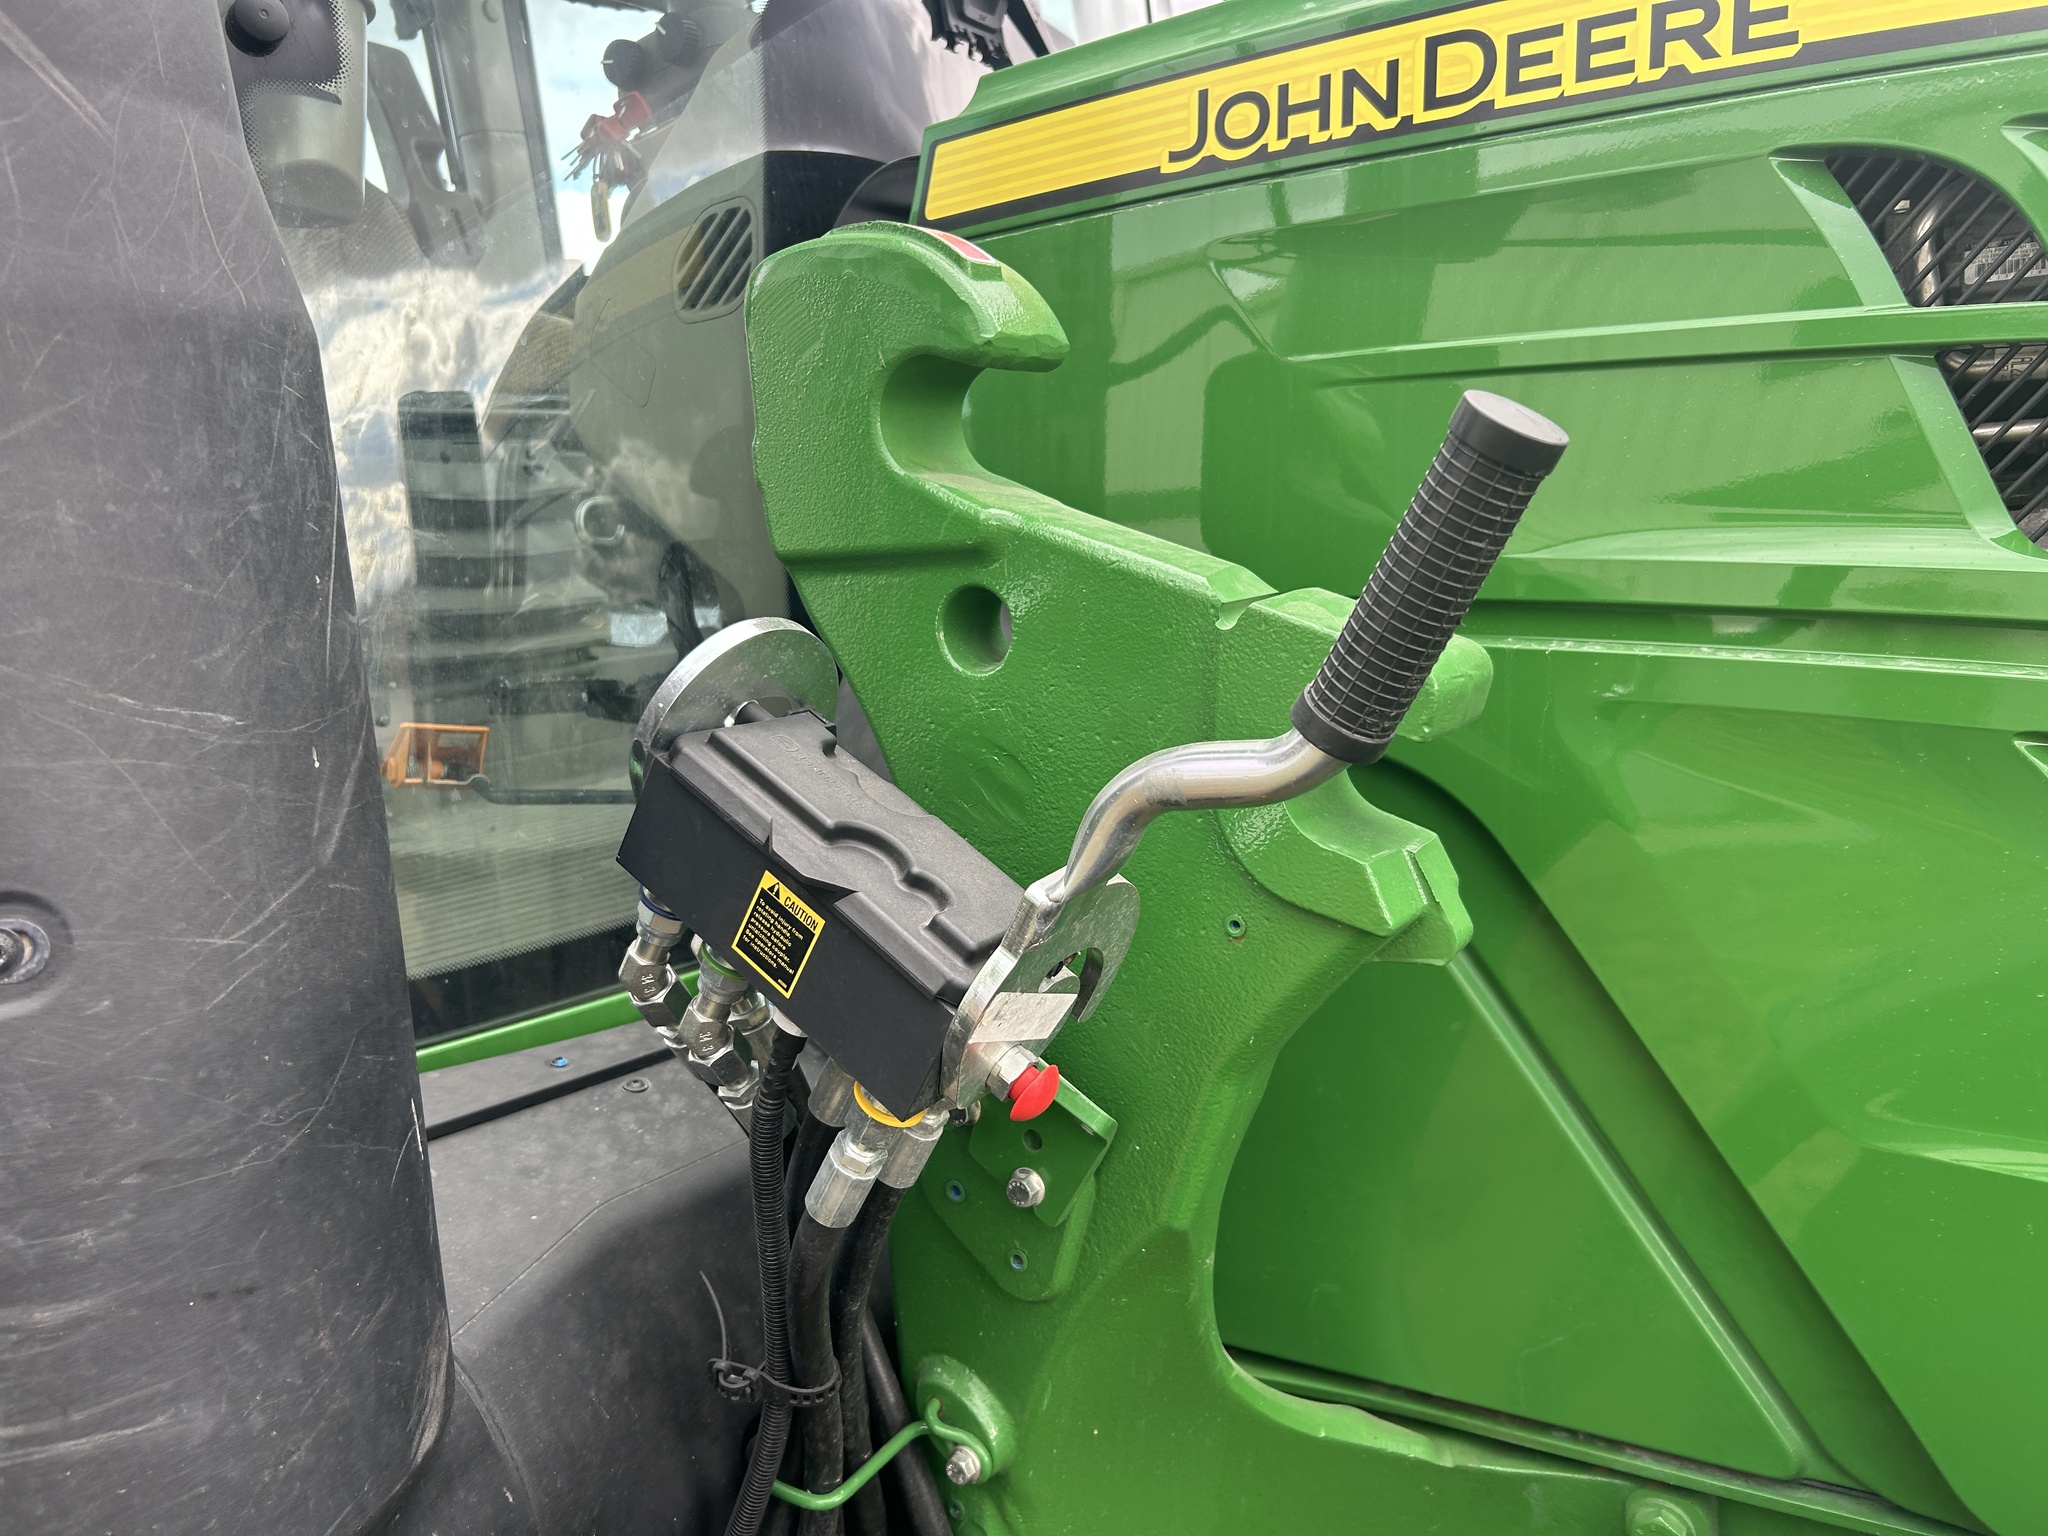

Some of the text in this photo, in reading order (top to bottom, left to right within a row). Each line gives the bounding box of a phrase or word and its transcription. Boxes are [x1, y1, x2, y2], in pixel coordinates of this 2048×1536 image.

[1167, 0, 1800, 164] JOHN DEERE
[753, 911, 791, 947] release hydraulic
[755, 905, 774, 923] rotating
[759, 897, 803, 940] To avoid injury from
[783, 896, 818, 931] CAUTION
[742, 934, 777, 968] for instructions.
[745, 928, 794, 974] See operators manual
[747, 923, 772, 946] unlatching
[750, 917, 786, 950] pressure before
